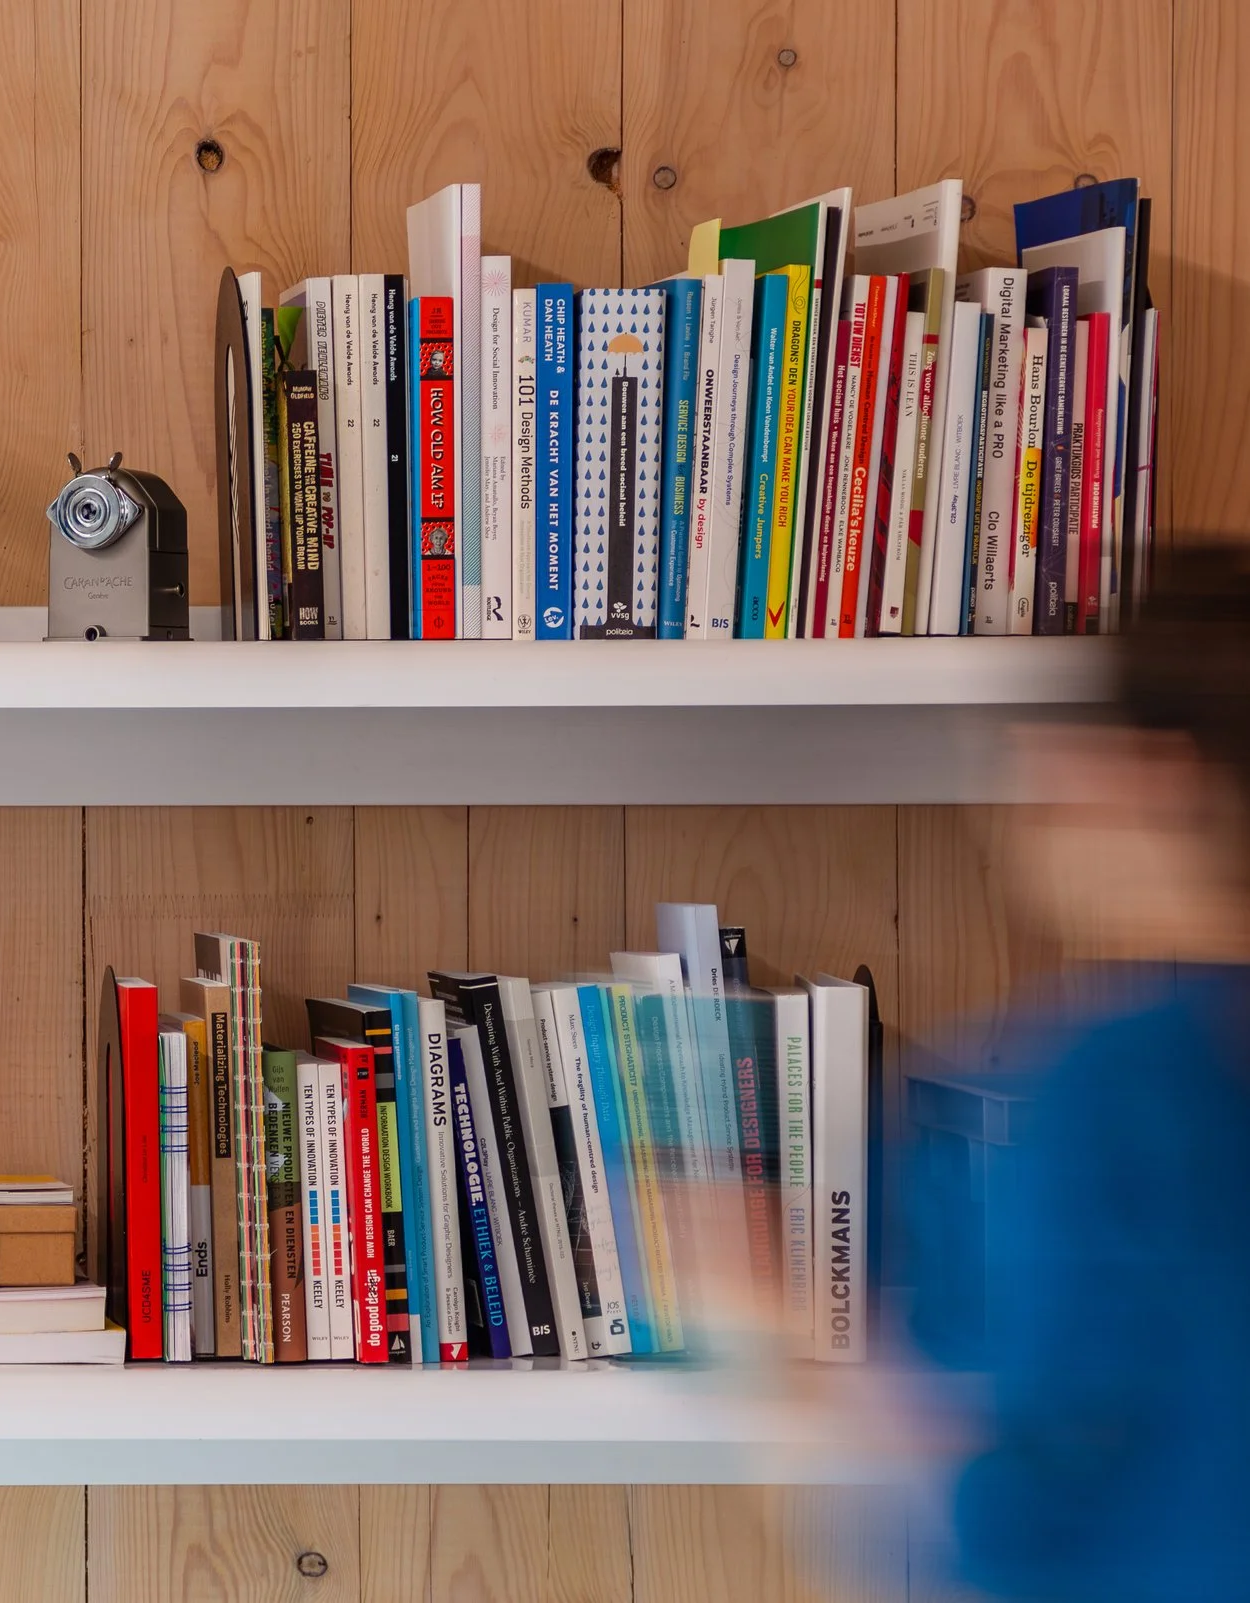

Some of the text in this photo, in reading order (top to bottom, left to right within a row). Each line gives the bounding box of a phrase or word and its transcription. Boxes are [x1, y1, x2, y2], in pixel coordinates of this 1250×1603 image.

[386, 289, 396, 310] Henry
[998, 277, 1015, 318] Digital
[389, 325, 397, 334] de
[522, 301, 532, 343] KUMAR
[544, 298, 553, 361] DAN HEATH
[556, 298, 565, 374] CHIP HEATH &
[850, 303, 866, 369] TOT UW DIENST
[389, 336, 397, 356] Velde
[491, 307, 500, 410] Design for Social Innovation
[993, 323, 1012, 389] Marketing
[389, 357, 397, 381] Awards
[788, 367, 798, 385] DEN
[905, 352, 918, 417] THIS IS LEAN
[430, 387, 444, 429] HOW
[518, 374, 535, 407] 101
[621, 381, 629, 413] Bouwen
[786, 388, 797, 412] YOUR
[833, 365, 846, 424] Het sociaal huis
[995, 393, 1008, 416] like
[1027, 354, 1044, 449] Hans Bourlon
[677, 400, 688, 432] SERVICE
[699, 369, 714, 494] ONWEERSTAANBAAR
[724, 354, 741, 506] Design Journeys through Complex Systems
[785, 413, 795, 434] IDEA
[916, 351, 936, 479] Zorg voor allochtone ouderen
[303, 421, 317, 474] CAFFEINE
[391, 454, 398, 462] 21
[430, 433, 444, 459] OLD
[517, 412, 533, 509] Design Methods
[619, 448, 627, 471] breed
[676, 434, 687, 463] DESIGN
[783, 436, 793, 455] CAN
[992, 433, 1005, 459] PRO
[431, 463, 445, 489] AM
[549, 390, 559, 591] DE KRACHT VAN HET MOMENT
[619, 473, 627, 500] sociaal
[781, 457, 792, 483] MAKE
[292, 422, 306, 570] 250 EXERCISES TO WAKE UP YOUR BRAIN
[304, 485, 318, 534] CREATIVE
[618, 502, 627, 527] beleid
[674, 476, 685, 515] BUSINESS
[780, 485, 790, 503] YOU
[1018, 461, 1038, 558] De tijdreiziger
[693, 498, 707, 549] by design
[752, 473, 769, 560] Creative Jumpers
[778, 506, 788, 528] RICH
[306, 536, 320, 570] MIND
[846, 529, 861, 572] keuze
[984, 511, 1000, 590] Clo Willaerts
[63, 576, 100, 590] CARAN
[1048, 581, 1059, 616] politeia
[711, 618, 729, 629] BIS
[751, 596, 760, 621] acco
[215, 1013, 229, 1155] Materializing Technologies
[428, 1033, 447, 1127] DIAGRAMS
[735, 1057, 762, 1149] DESIGNERS
[786, 1036, 806, 1188] PALACES FOR THE PEOPLE
[483, 1003, 537, 1284] Designing With And Within Public Organizations André Schaminée
[574, 1057, 600, 1194] The fragility of human-centred design
[379, 1105, 394, 1209] INFORMATION DESIGN WORKBOOK
[744, 1153, 764, 1185] FOR
[282, 1102, 296, 1279] NIEUWE PRODUCTEN EN DIENSTEN
[303, 1084, 323, 1309] TEN TYPES OF INNOVATION KEELEY
[326, 1084, 345, 1309] TEN TYPES OF INNOVATION KEELEY
[454, 1082, 503, 1327] TECHNOLOGIE, ETHIEK & BELEID
[386, 1229, 396, 1247] BAER
[831, 1190, 851, 1350] BOLCKMANS
[281, 1293, 292, 1343] PEARSON
[531, 1324, 551, 1336] BIS
